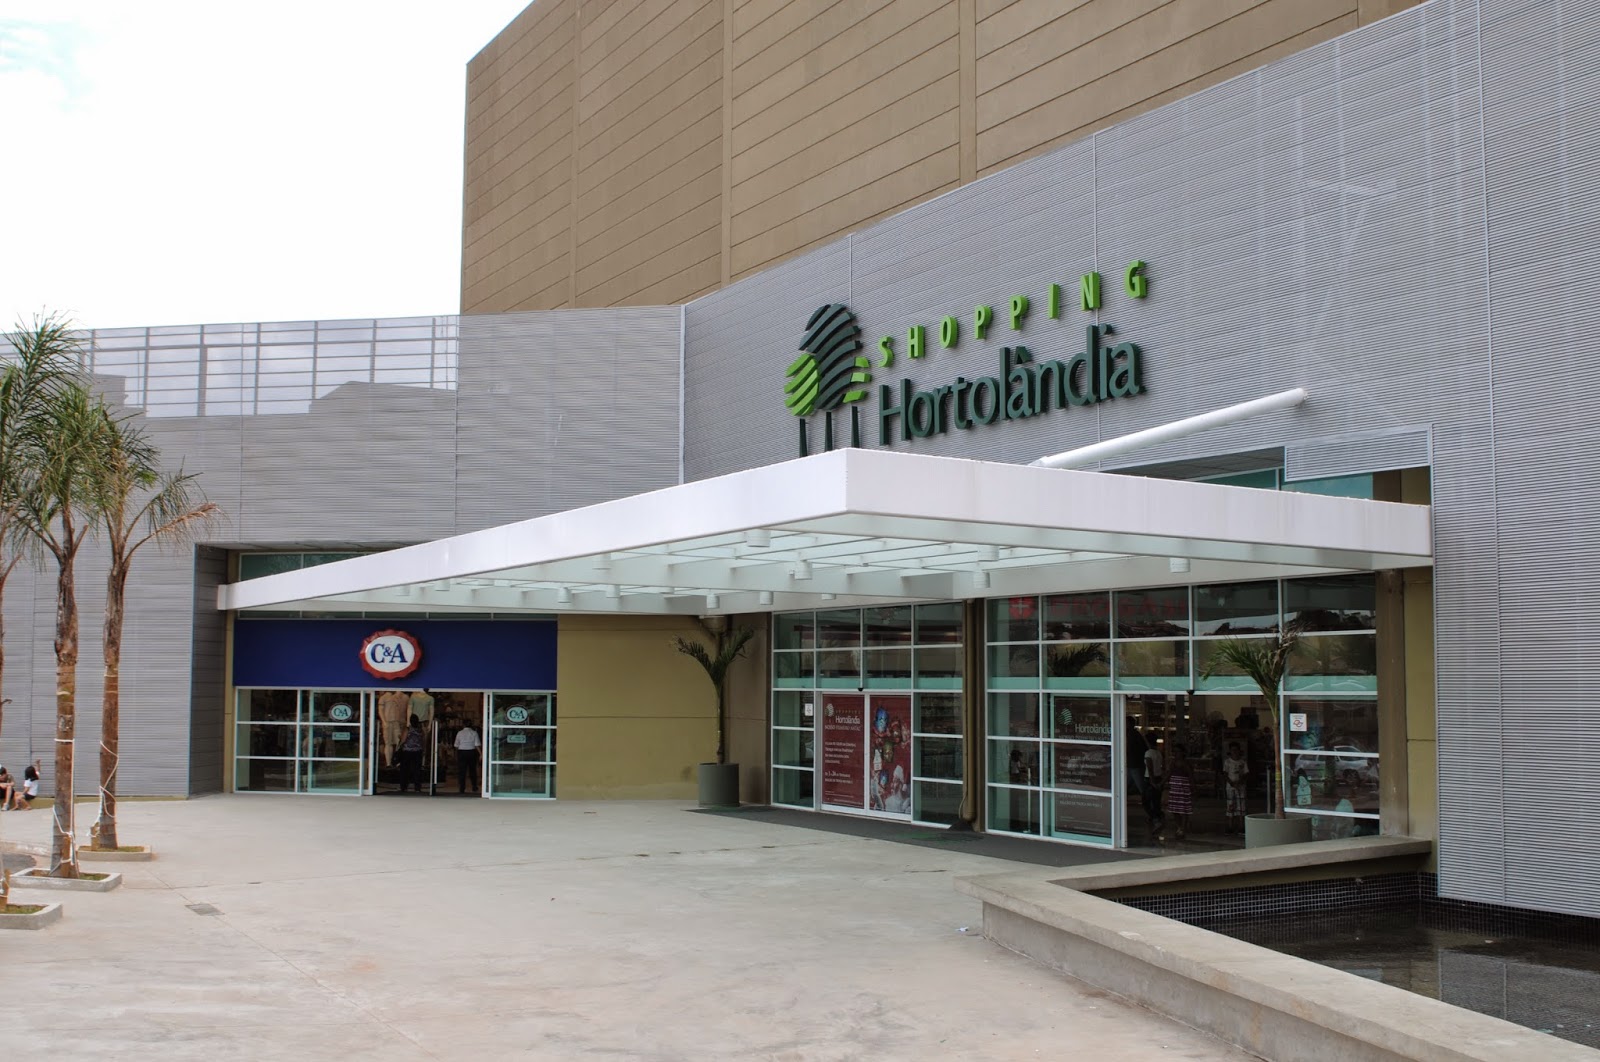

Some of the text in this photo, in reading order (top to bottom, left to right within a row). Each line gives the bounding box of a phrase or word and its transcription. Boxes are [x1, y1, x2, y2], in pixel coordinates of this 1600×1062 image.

[877, 259, 1148, 368] SHOPPING
[878, 323, 1146, 446] Hortolândia
[370, 643, 408, 664] C&A
[333, 707, 348, 717] C&A
[509, 709, 525, 719] C&A
